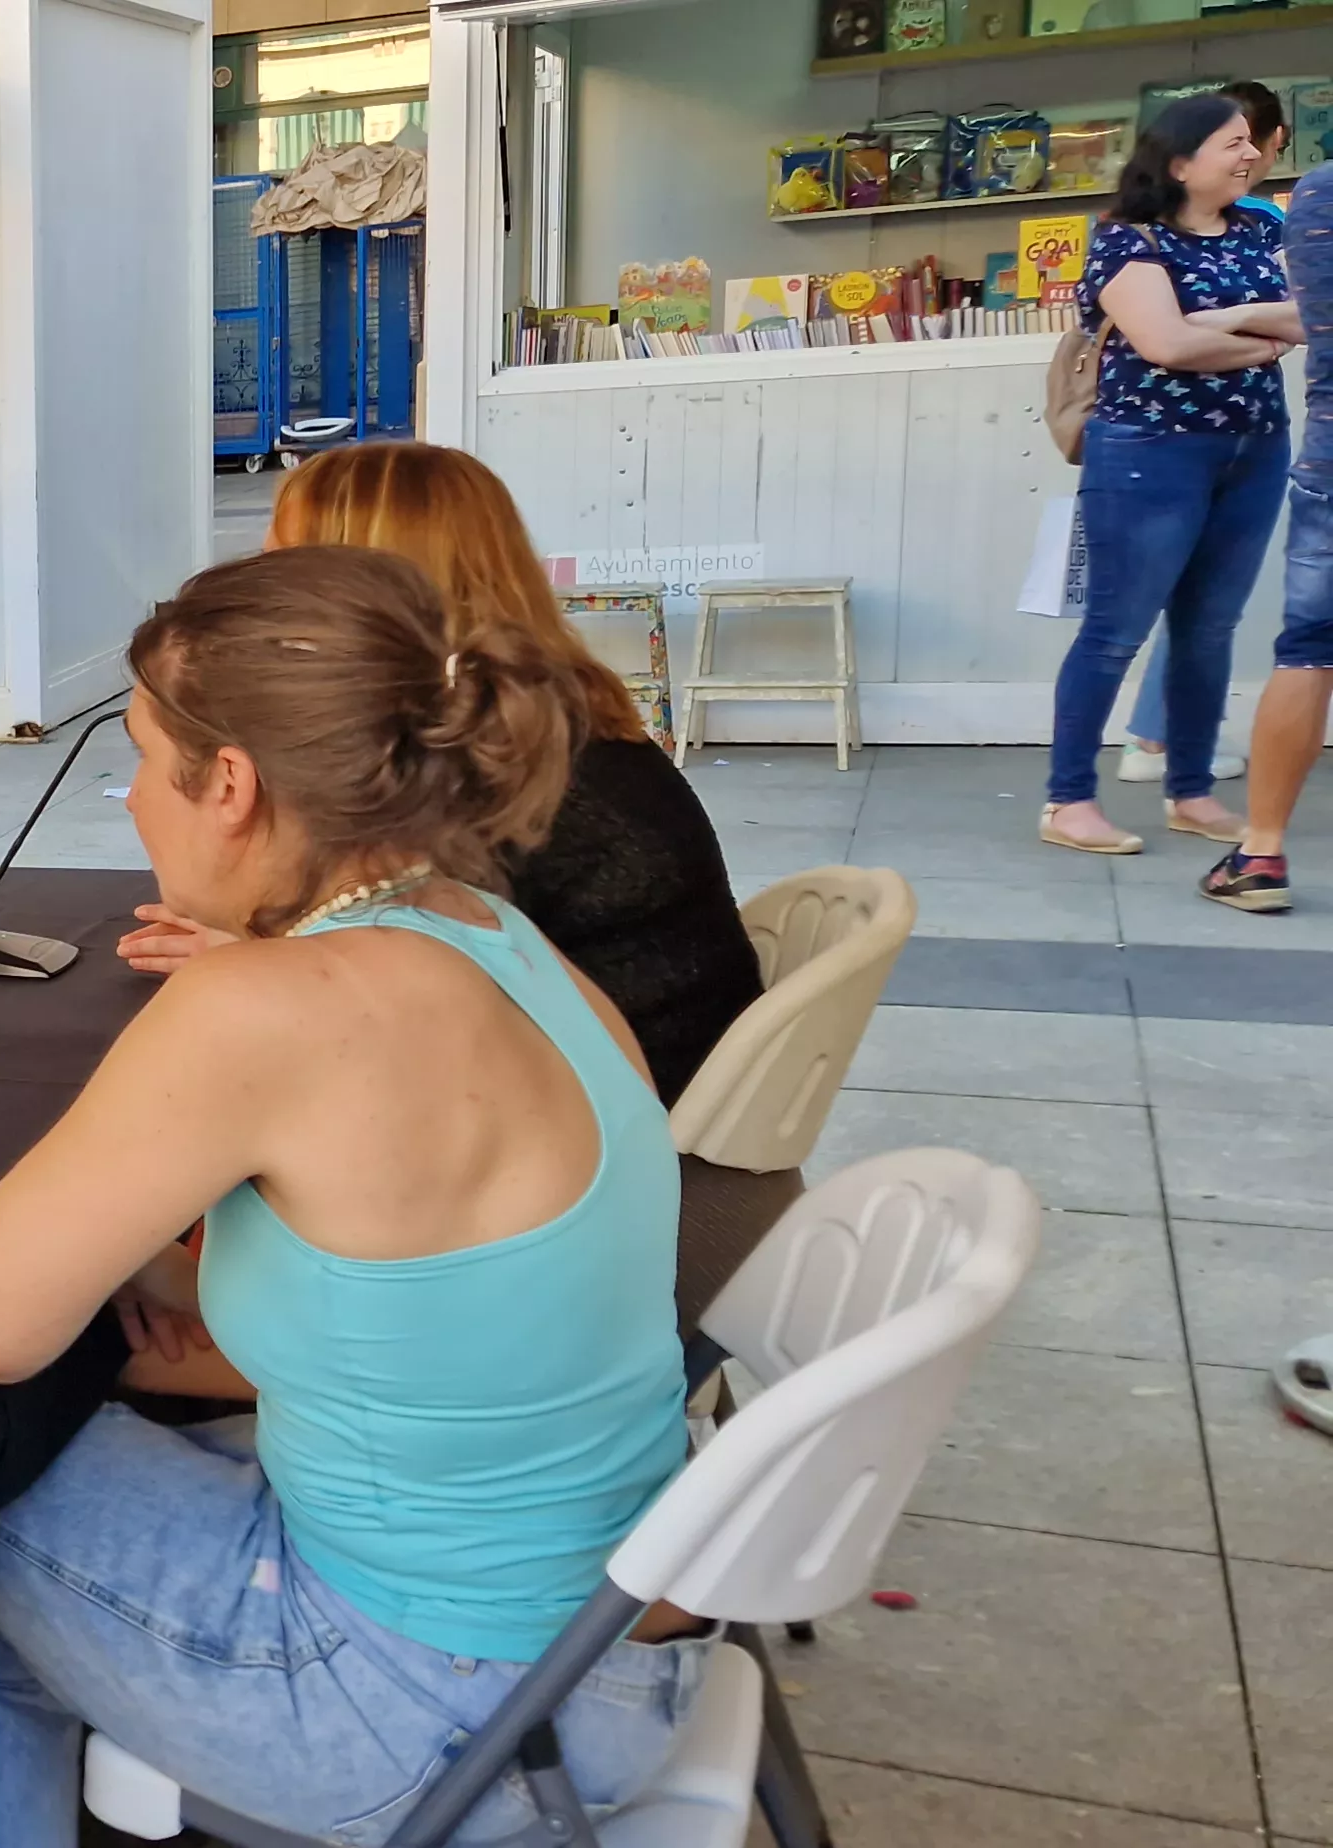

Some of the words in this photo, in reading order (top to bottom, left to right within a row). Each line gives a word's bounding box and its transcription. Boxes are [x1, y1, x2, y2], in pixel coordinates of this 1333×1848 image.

[1035, 230, 1051, 239] OH
[1054, 228, 1071, 237] MY
[586, 553, 754, 579] Ayuntamiento
